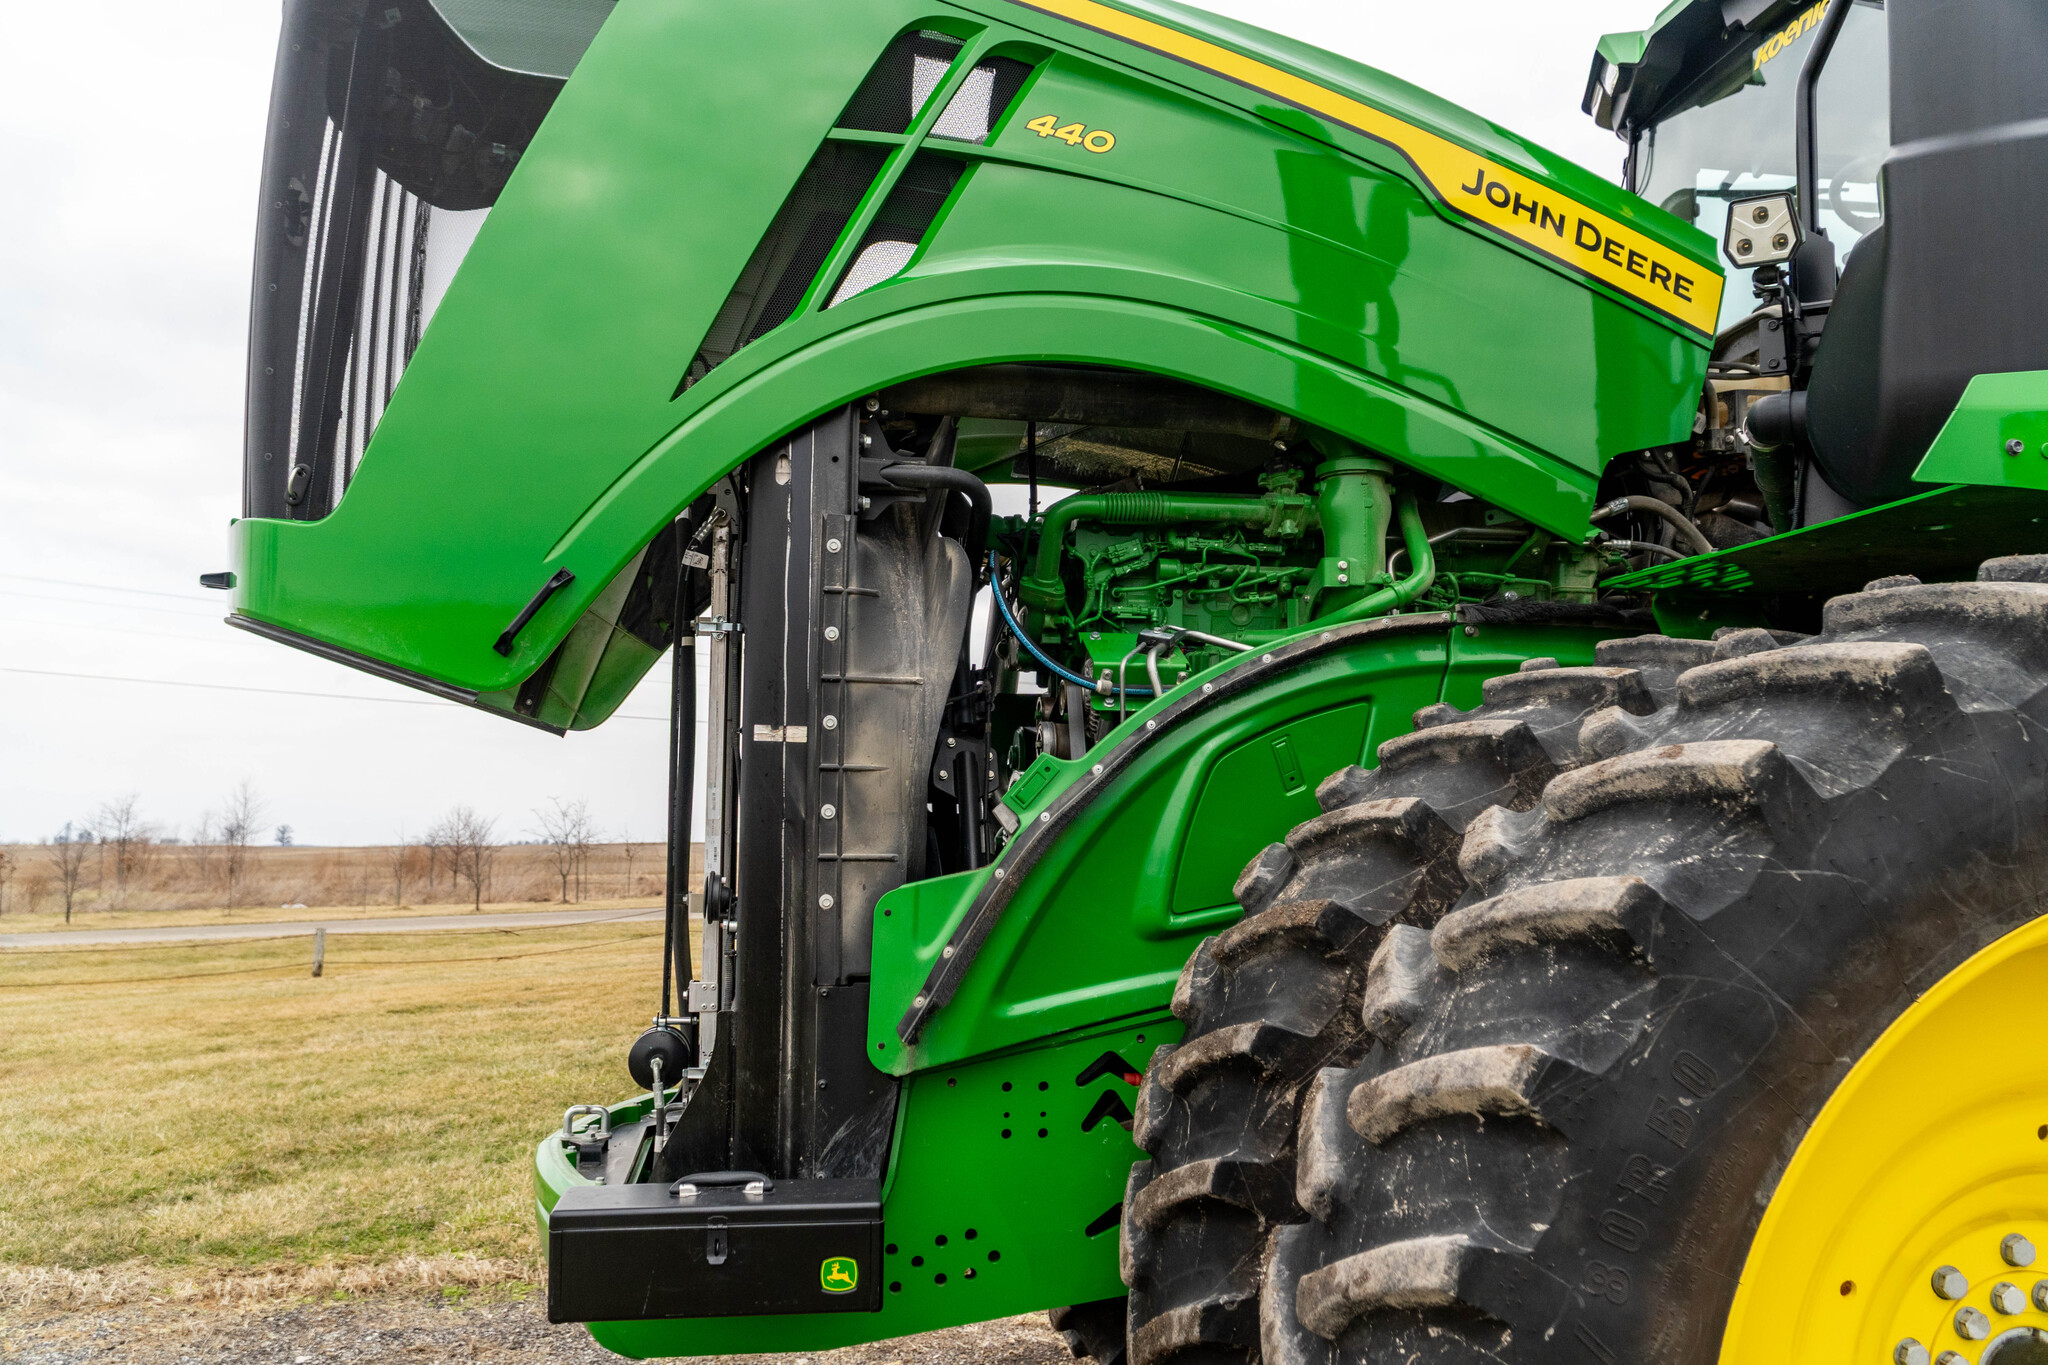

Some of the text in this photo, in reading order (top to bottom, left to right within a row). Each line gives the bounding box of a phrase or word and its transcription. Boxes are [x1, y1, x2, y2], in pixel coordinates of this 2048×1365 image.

[1025, 114, 1116, 154] 440
[1461, 168, 1695, 304] JOHN DEERE
